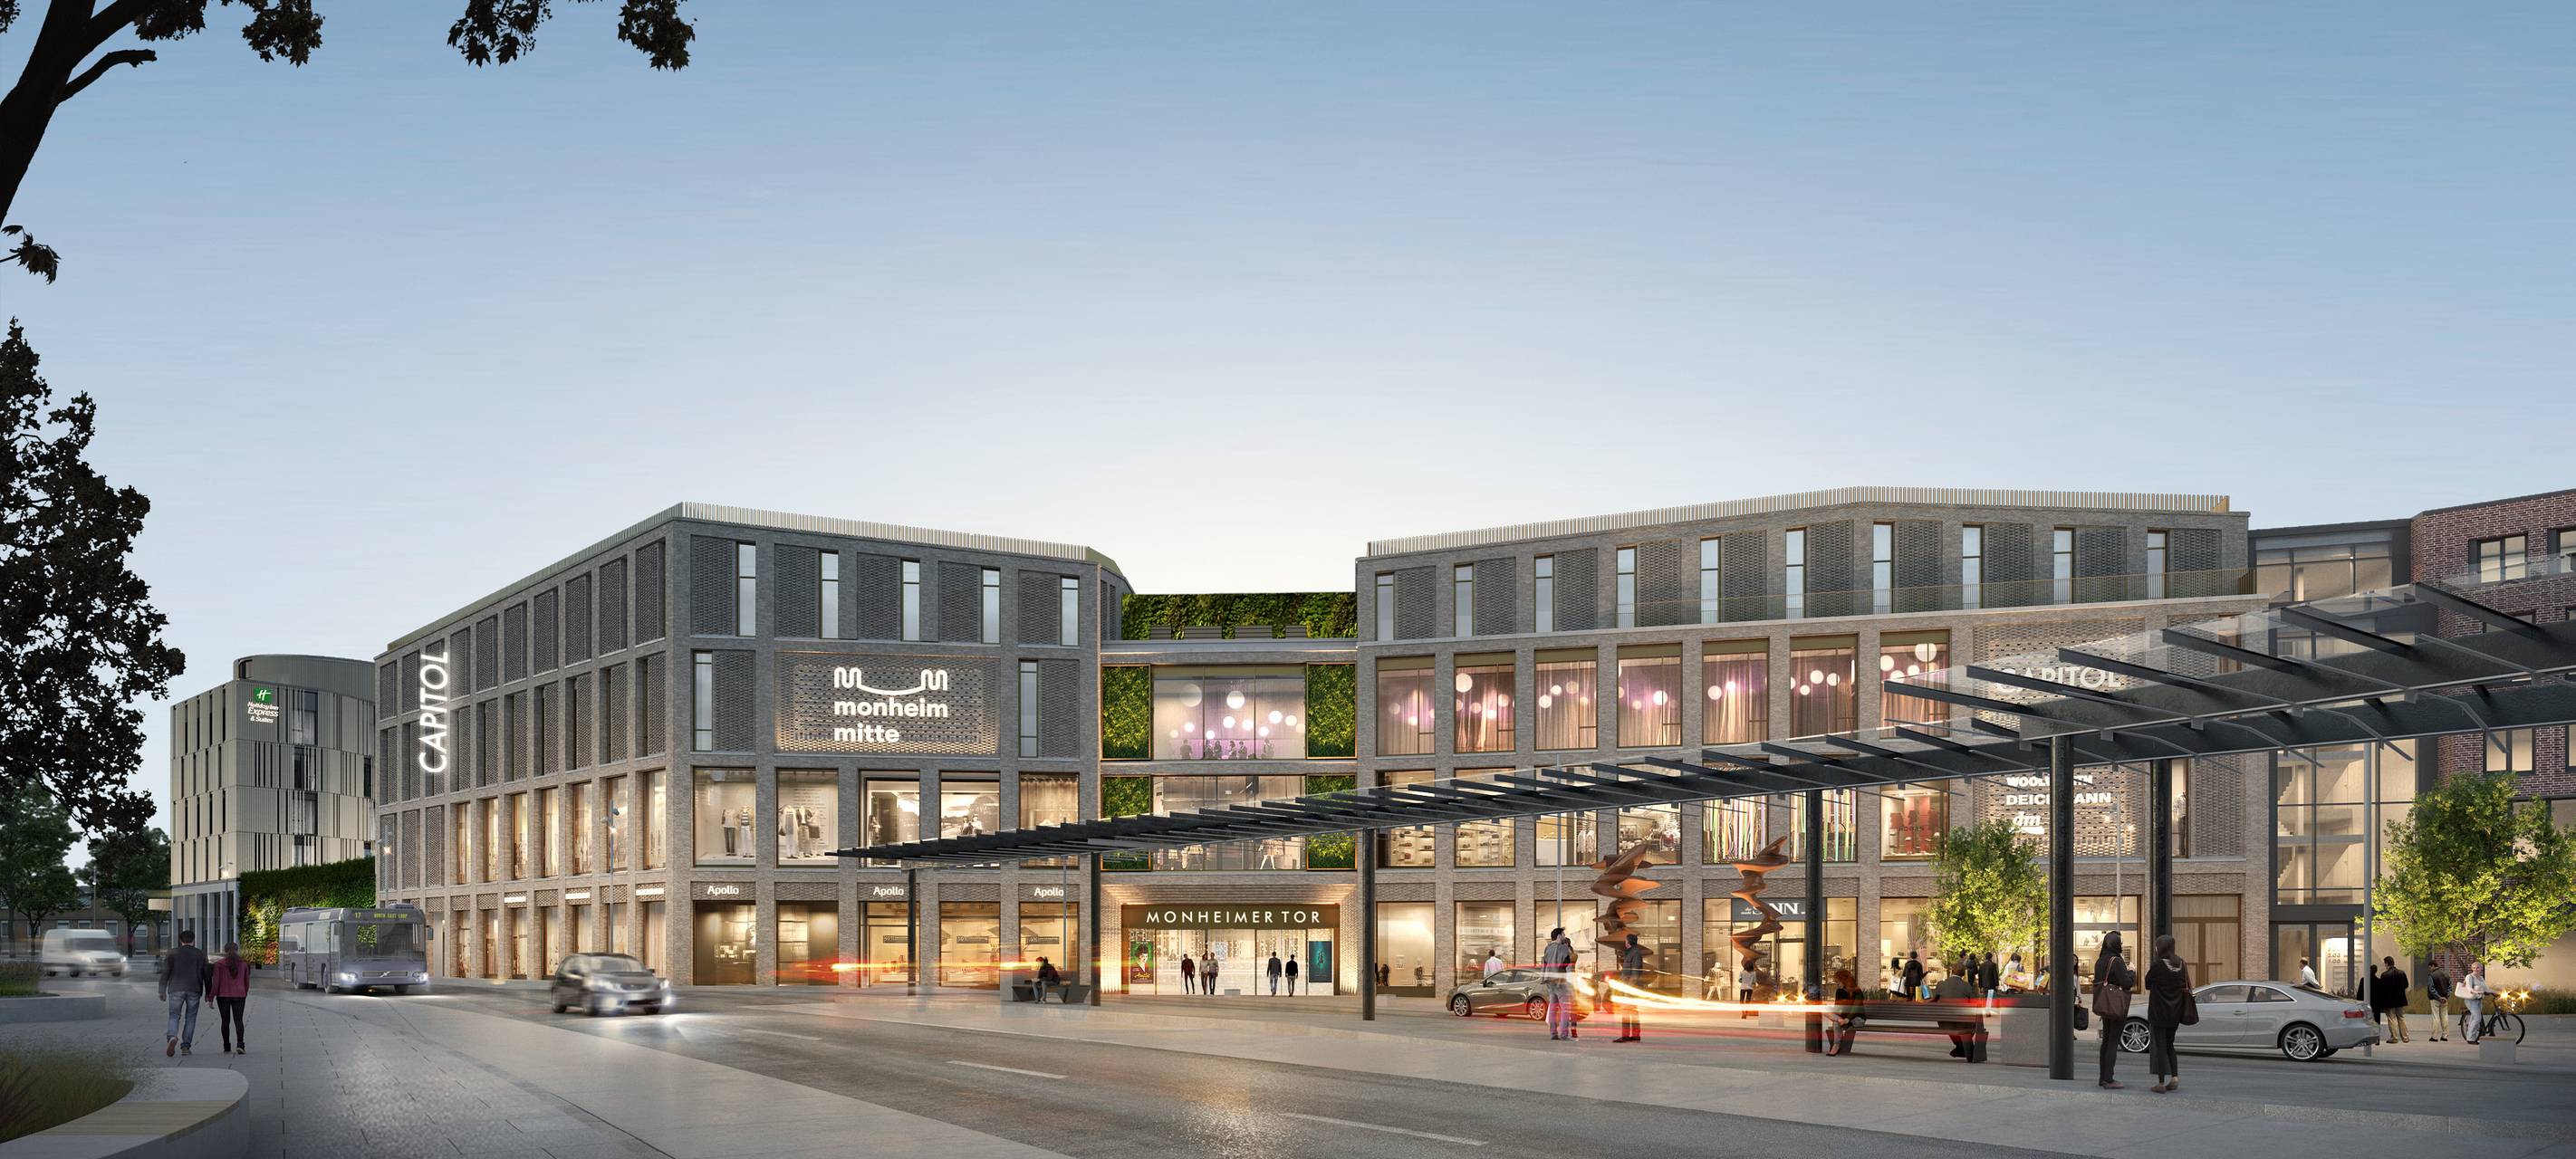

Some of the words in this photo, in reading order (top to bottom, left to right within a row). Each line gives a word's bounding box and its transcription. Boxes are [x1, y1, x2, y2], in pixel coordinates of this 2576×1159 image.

[247, 706, 279, 717] Express
[418, 651, 448, 773] CAPITOL
[834, 697, 948, 718] monheim
[834, 723, 899, 742] mitte
[2006, 792, 2111, 805] DEICANN
[2013, 811, 2041, 827] dm
[706, 886, 739, 896] Apollo
[872, 886, 904, 896] Apollo
[1033, 886, 1064, 898] Apollo
[1146, 911, 1273, 924] MONHEIMER
[1282, 911, 1320, 924] TOR
